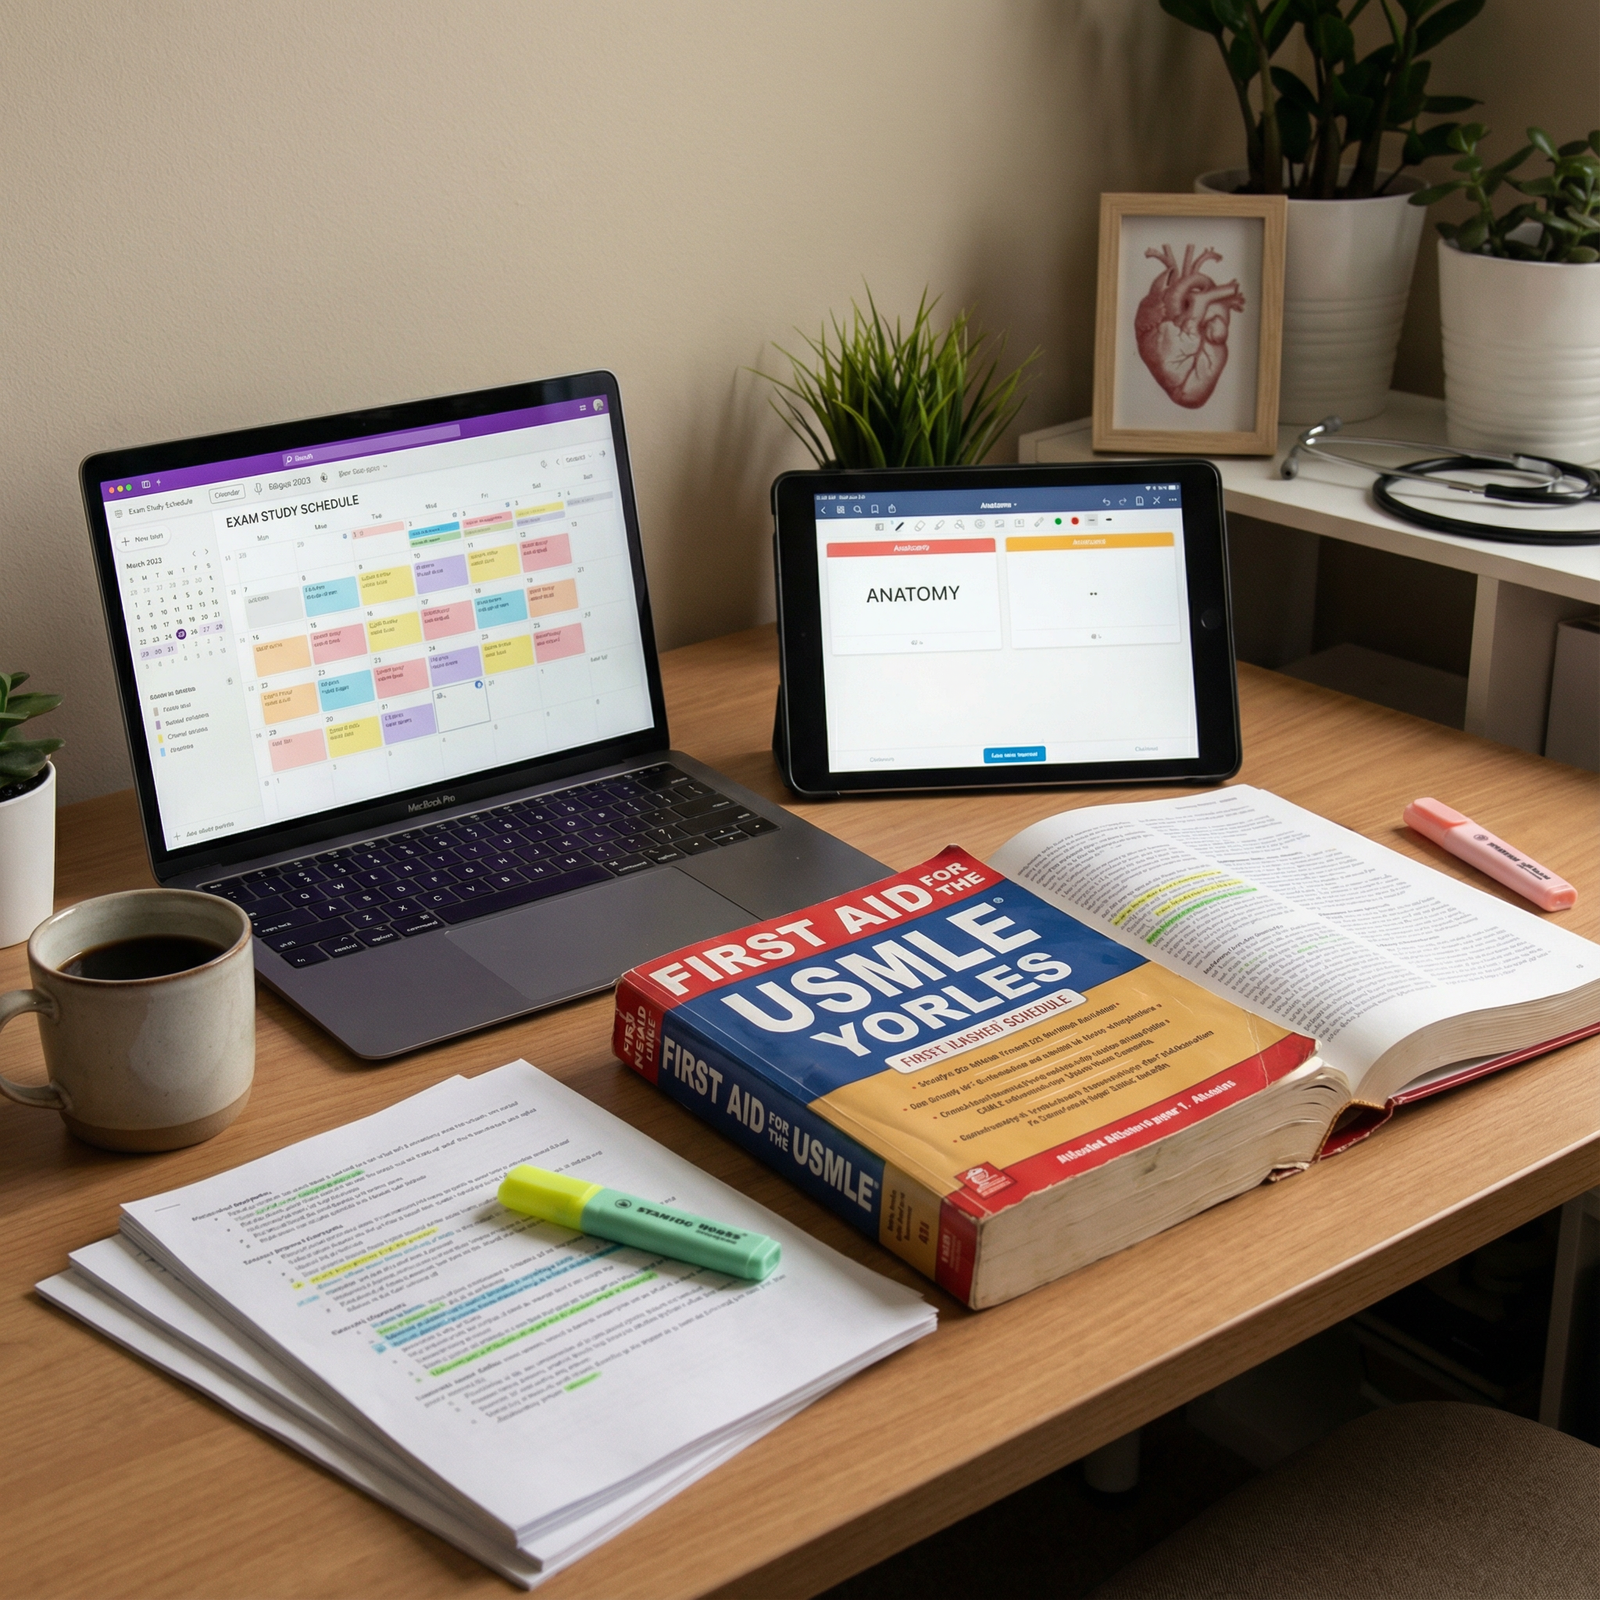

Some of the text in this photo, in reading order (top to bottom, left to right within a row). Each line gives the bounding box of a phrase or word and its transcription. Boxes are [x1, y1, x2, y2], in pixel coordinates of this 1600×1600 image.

[226, 495, 360, 528] EXAM STUDY SCHEDULE
[866, 585, 960, 603] ANATOMY
[918, 861, 969, 887] FOR
[934, 871, 986, 898] THE
[648, 883, 933, 997] FIRST AID
[809, 952, 1072, 1057] YORLES
[1003, 994, 1072, 1028] SCHEDULE
[662, 1036, 765, 1135] FIRST AID
[768, 1111, 790, 1135] FOR
[768, 1128, 789, 1152] THE
